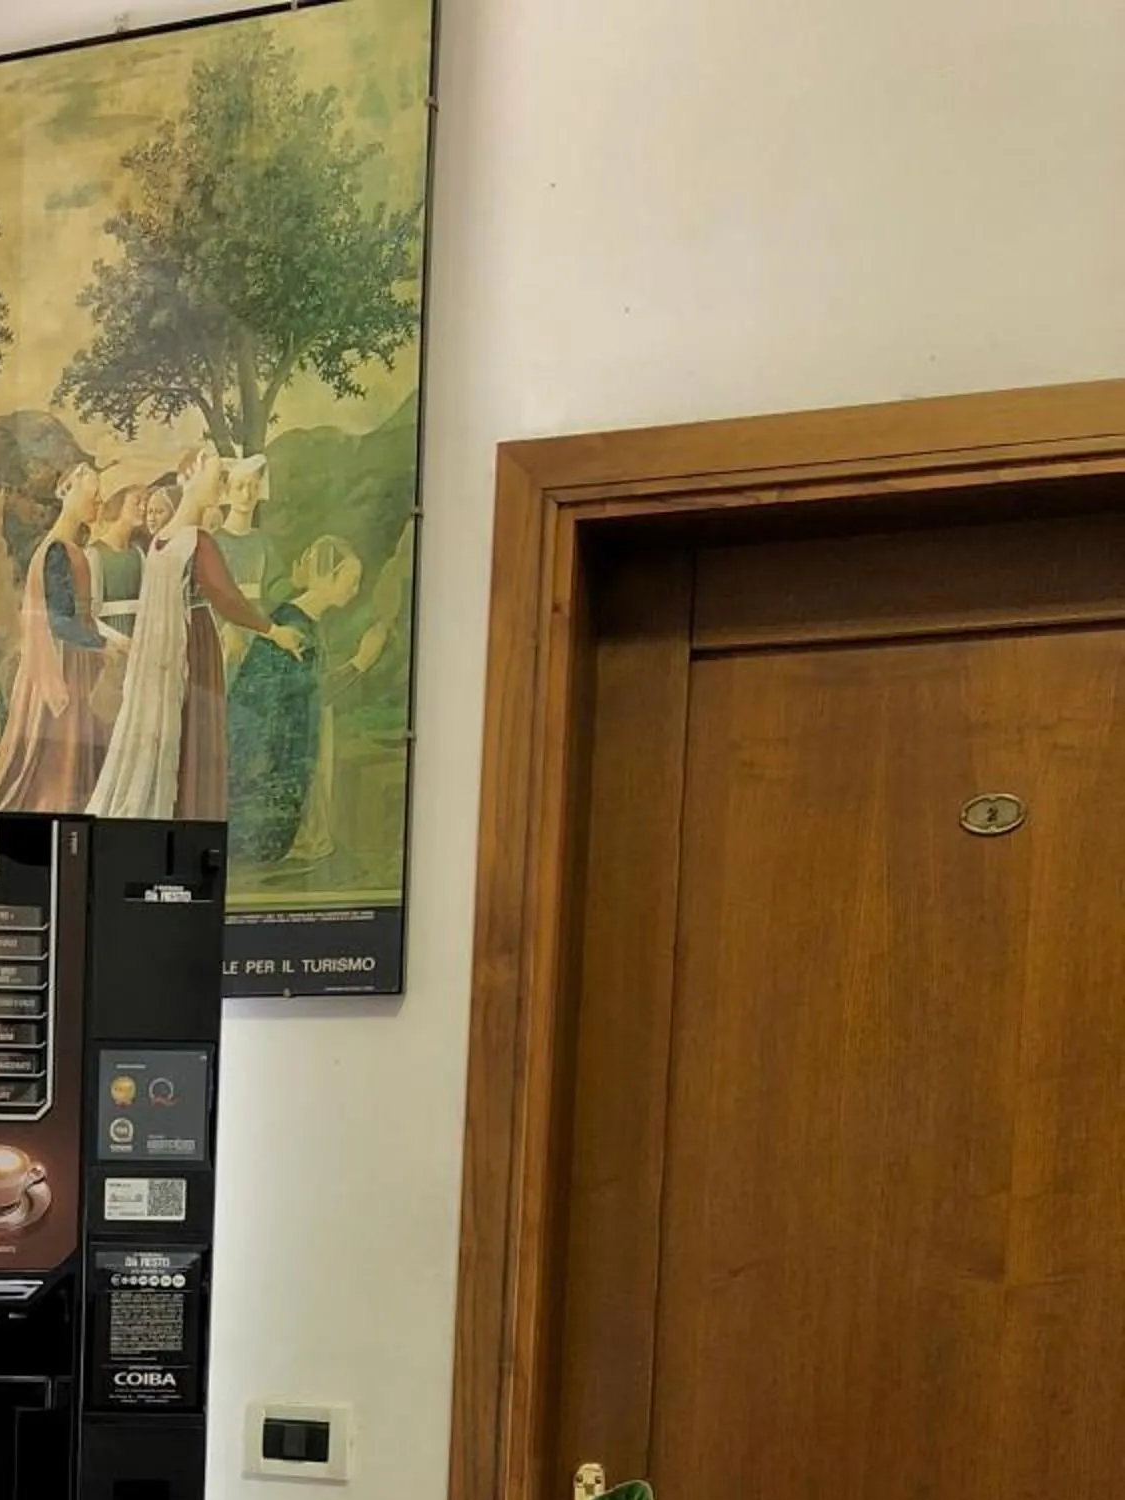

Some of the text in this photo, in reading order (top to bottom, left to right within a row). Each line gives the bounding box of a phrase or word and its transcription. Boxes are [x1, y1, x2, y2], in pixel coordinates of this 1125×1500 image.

[245, 959, 275, 974] PER
[282, 959, 295, 973] IL
[302, 957, 376, 973] TURISMO
[114, 1371, 177, 1386] COIBA
